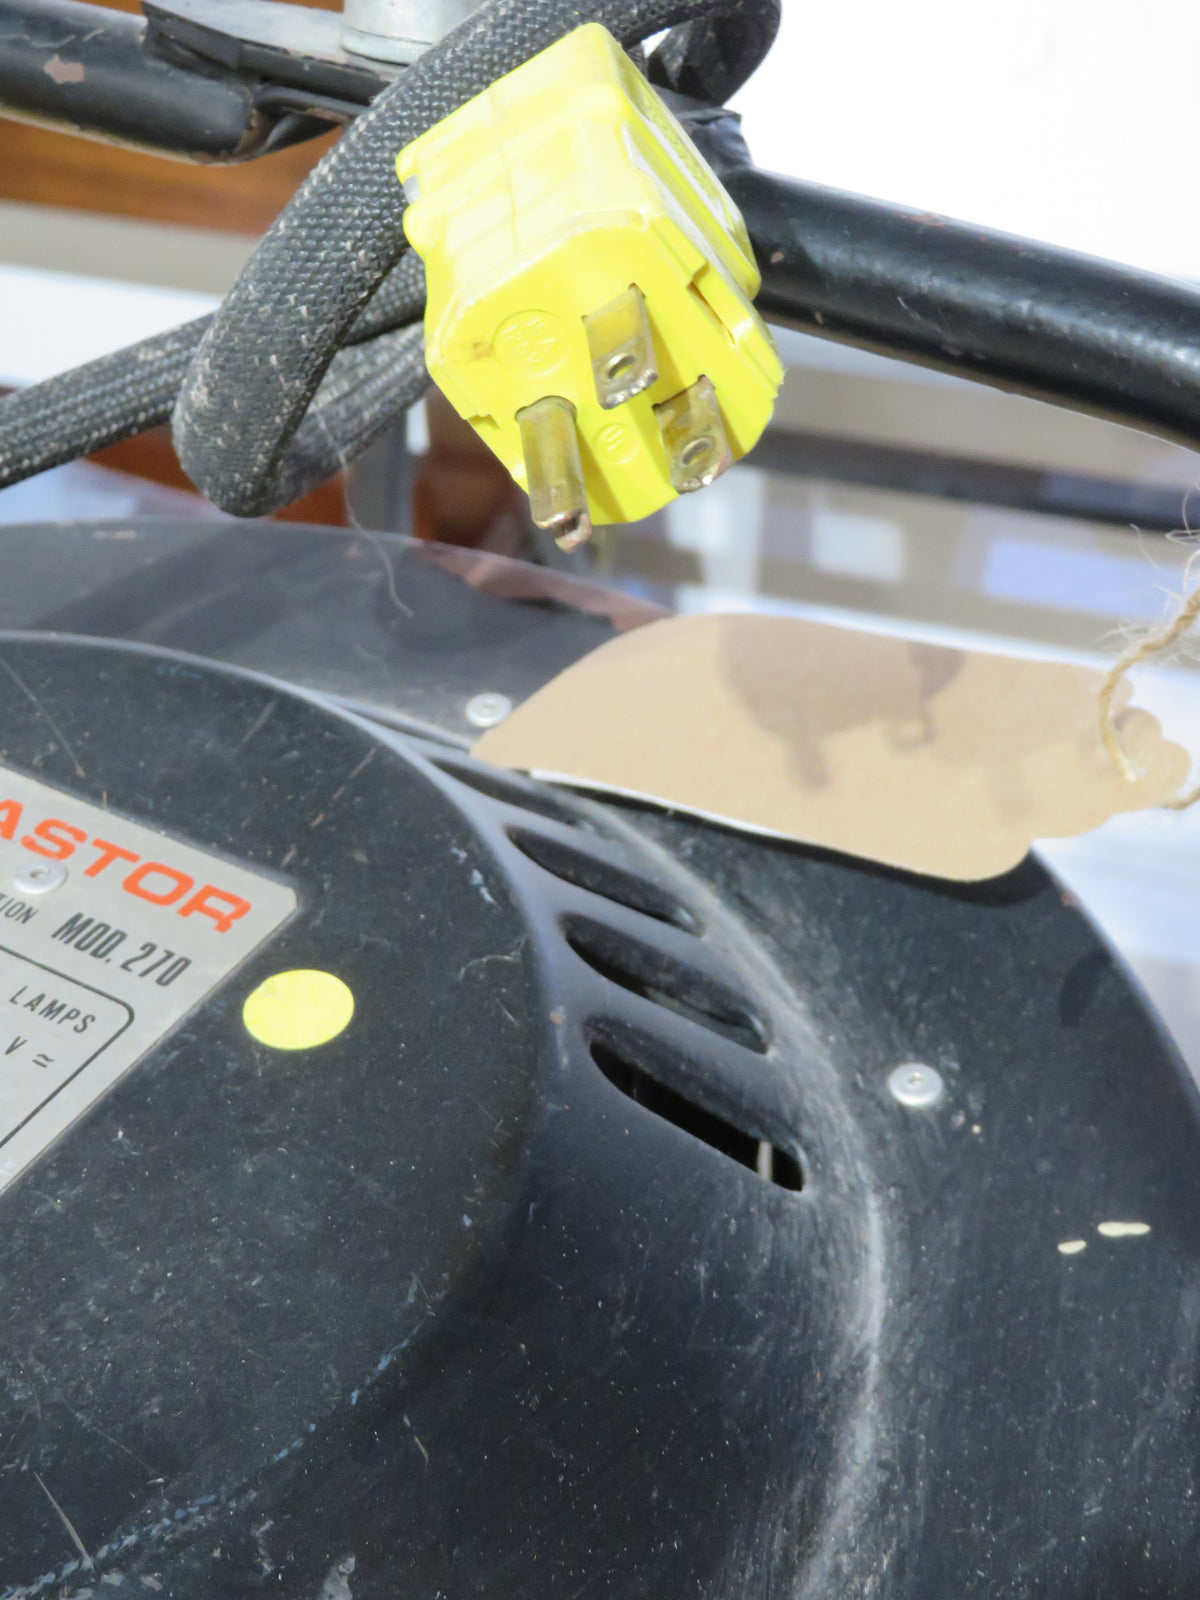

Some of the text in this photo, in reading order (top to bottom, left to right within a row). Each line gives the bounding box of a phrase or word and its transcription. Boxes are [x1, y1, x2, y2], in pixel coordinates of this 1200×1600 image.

[50, 912, 127, 963] MOD.
[119, 942, 193, 987] 270
[9, 985, 96, 1033] LAMPS
[5, 1036, 28, 1055] V
